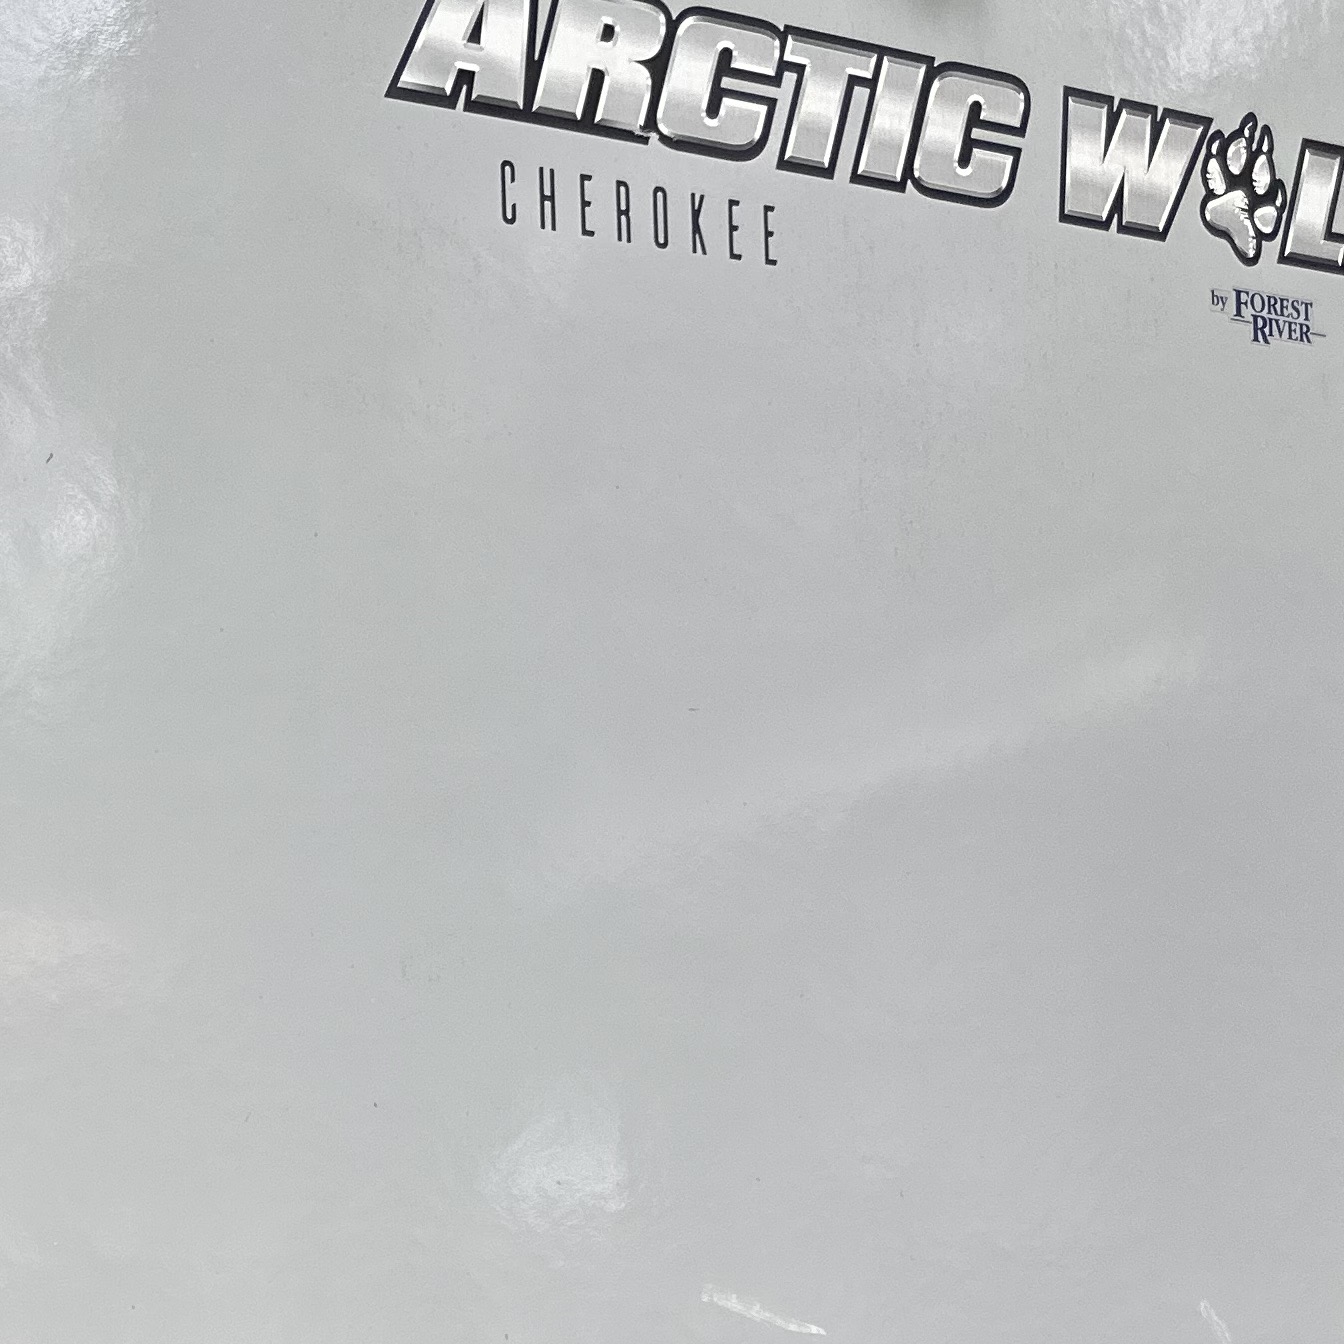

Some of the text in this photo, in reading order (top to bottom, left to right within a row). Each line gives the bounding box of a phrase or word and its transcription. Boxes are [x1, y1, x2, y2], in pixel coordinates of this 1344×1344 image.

[384, 0, 1031, 209] ARCTIC
[500, 159, 778, 267] CHEROKEE
[1210, 288, 1314, 322] by FOREST
[1250, 313, 1313, 345] RIVER
